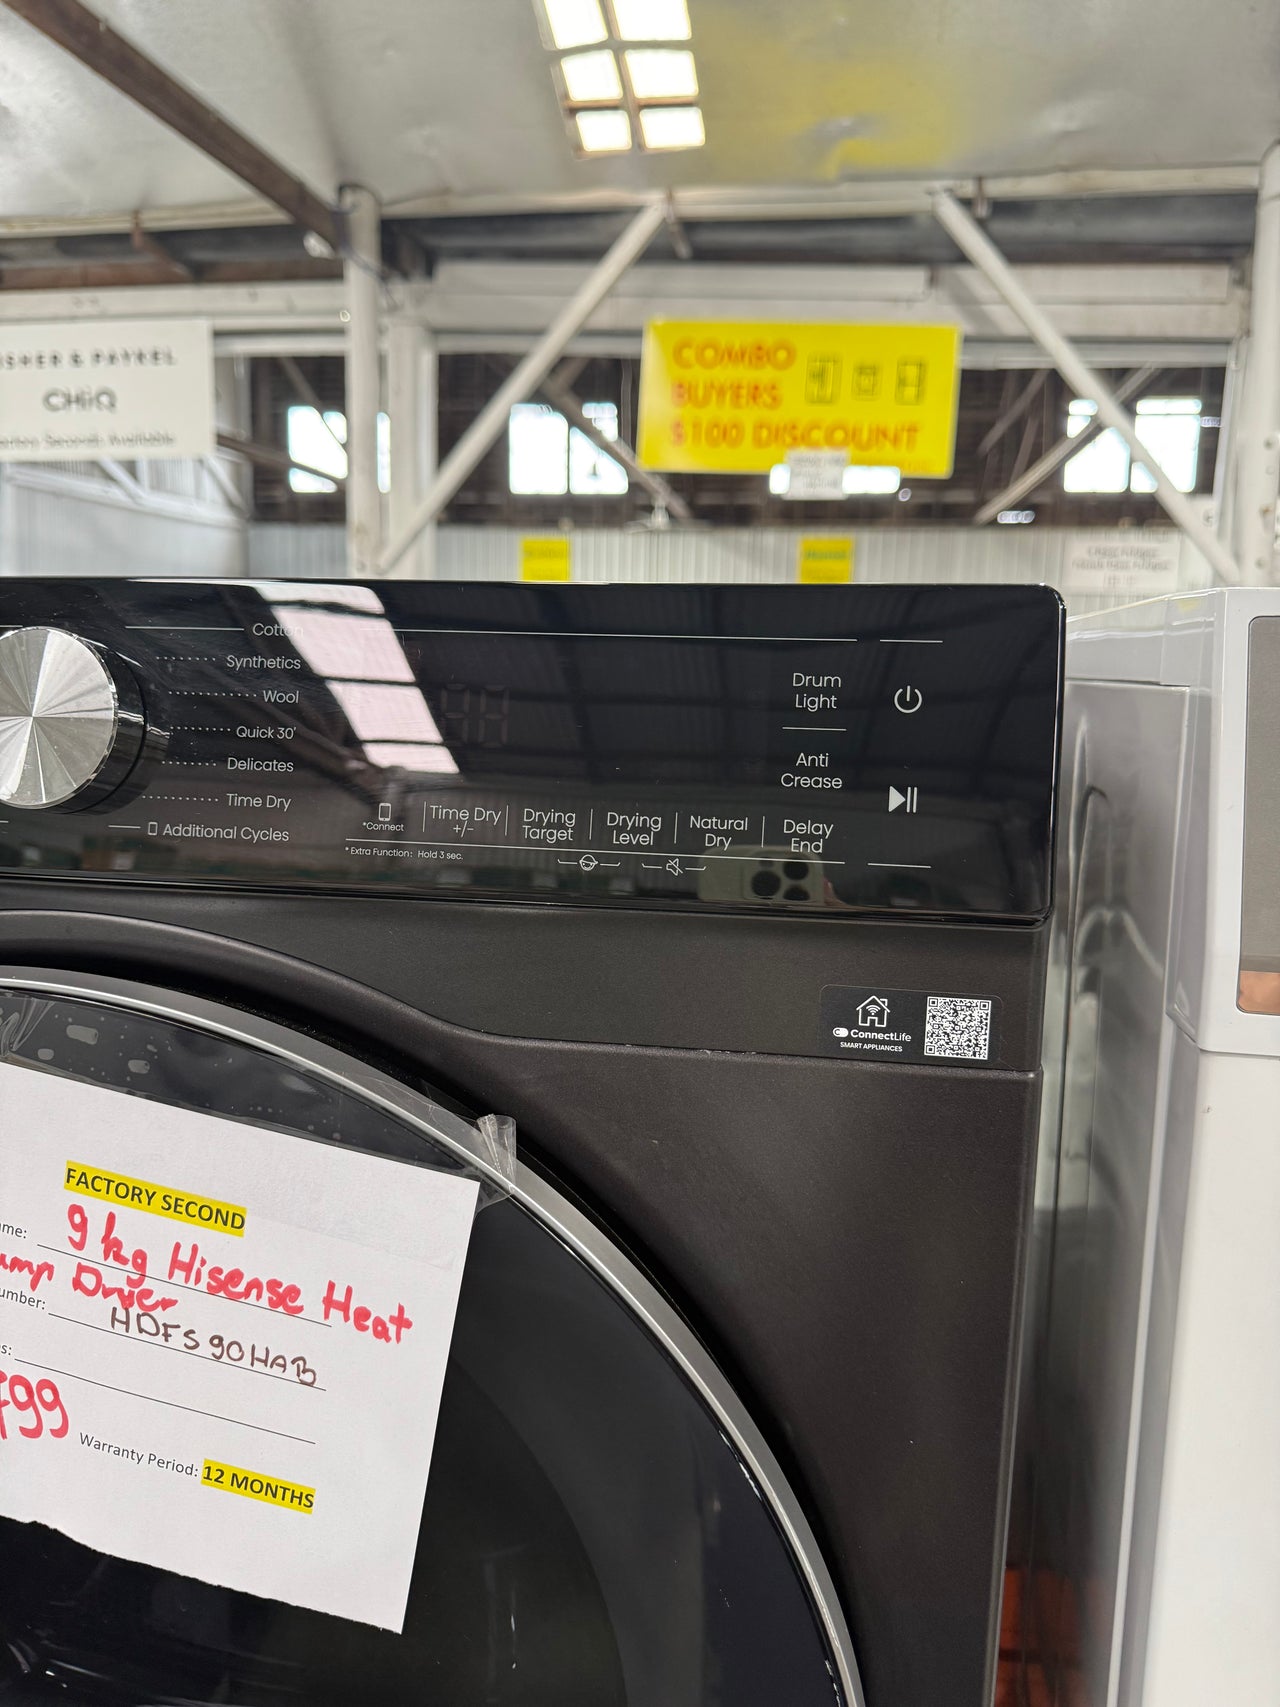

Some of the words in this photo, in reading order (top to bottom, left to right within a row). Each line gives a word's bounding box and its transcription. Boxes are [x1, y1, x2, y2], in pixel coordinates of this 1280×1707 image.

[0, 351, 64, 369] SHER
[672, 337, 797, 371] COMBO
[672, 379, 783, 410] BUYERS
[672, 420, 744, 449] $100
[753, 420, 920, 452] DISCOUNT
[252, 622, 304, 638] Cotton
[226, 655, 301, 671] Synthetics
[792, 672, 842, 688] Drum
[263, 690, 299, 704] Wool
[795, 693, 838, 712] Light
[236, 726, 275, 740] Quick
[227, 757, 294, 772] Delicates
[795, 752, 829, 768] Anti
[780, 773, 843, 789] Crease
[226, 793, 263, 808] Time
[266, 795, 292, 812] Dry
[430, 805, 470, 821] Time
[474, 807, 502, 826] Dry
[523, 808, 576, 827] Drying
[606, 812, 662, 832] Drying
[689, 815, 749, 831] Natural
[162, 823, 237, 840] Additional
[240, 827, 290, 843] Cycles
[522, 825, 574, 844] Target
[612, 830, 654, 846] Level
[783, 819, 834, 839] Delay
[705, 833, 732, 851] Dry
[790, 837, 823, 853] End
[373, 847, 413, 858] Function:
[417, 849, 438, 859] Hold
[439, 851, 445, 859] 3
[446, 852, 464, 860] sec.
[850, 1029, 912, 1042] ConnectLife
[840, 1041, 862, 1050] SMART
[863, 1042, 903, 1053] APPLIANCES
[66, 1167, 157, 1206] FACTORY
[160, 1194, 246, 1230] SECOND
[0, 1222, 27, 1239] me:
[67, 1204, 88, 1251] 9
[101, 1211, 148, 1289] kg
[167, 1241, 304, 1315] Hisense
[322, 1280, 413, 1344] Heat
[72, 1262, 178, 1312] Dryer
[79, 1432, 144, 1464] Warranty
[148, 1453, 199, 1477] Period:
[202, 1465, 225, 1484] 12
[230, 1472, 314, 1509] MONTHS
